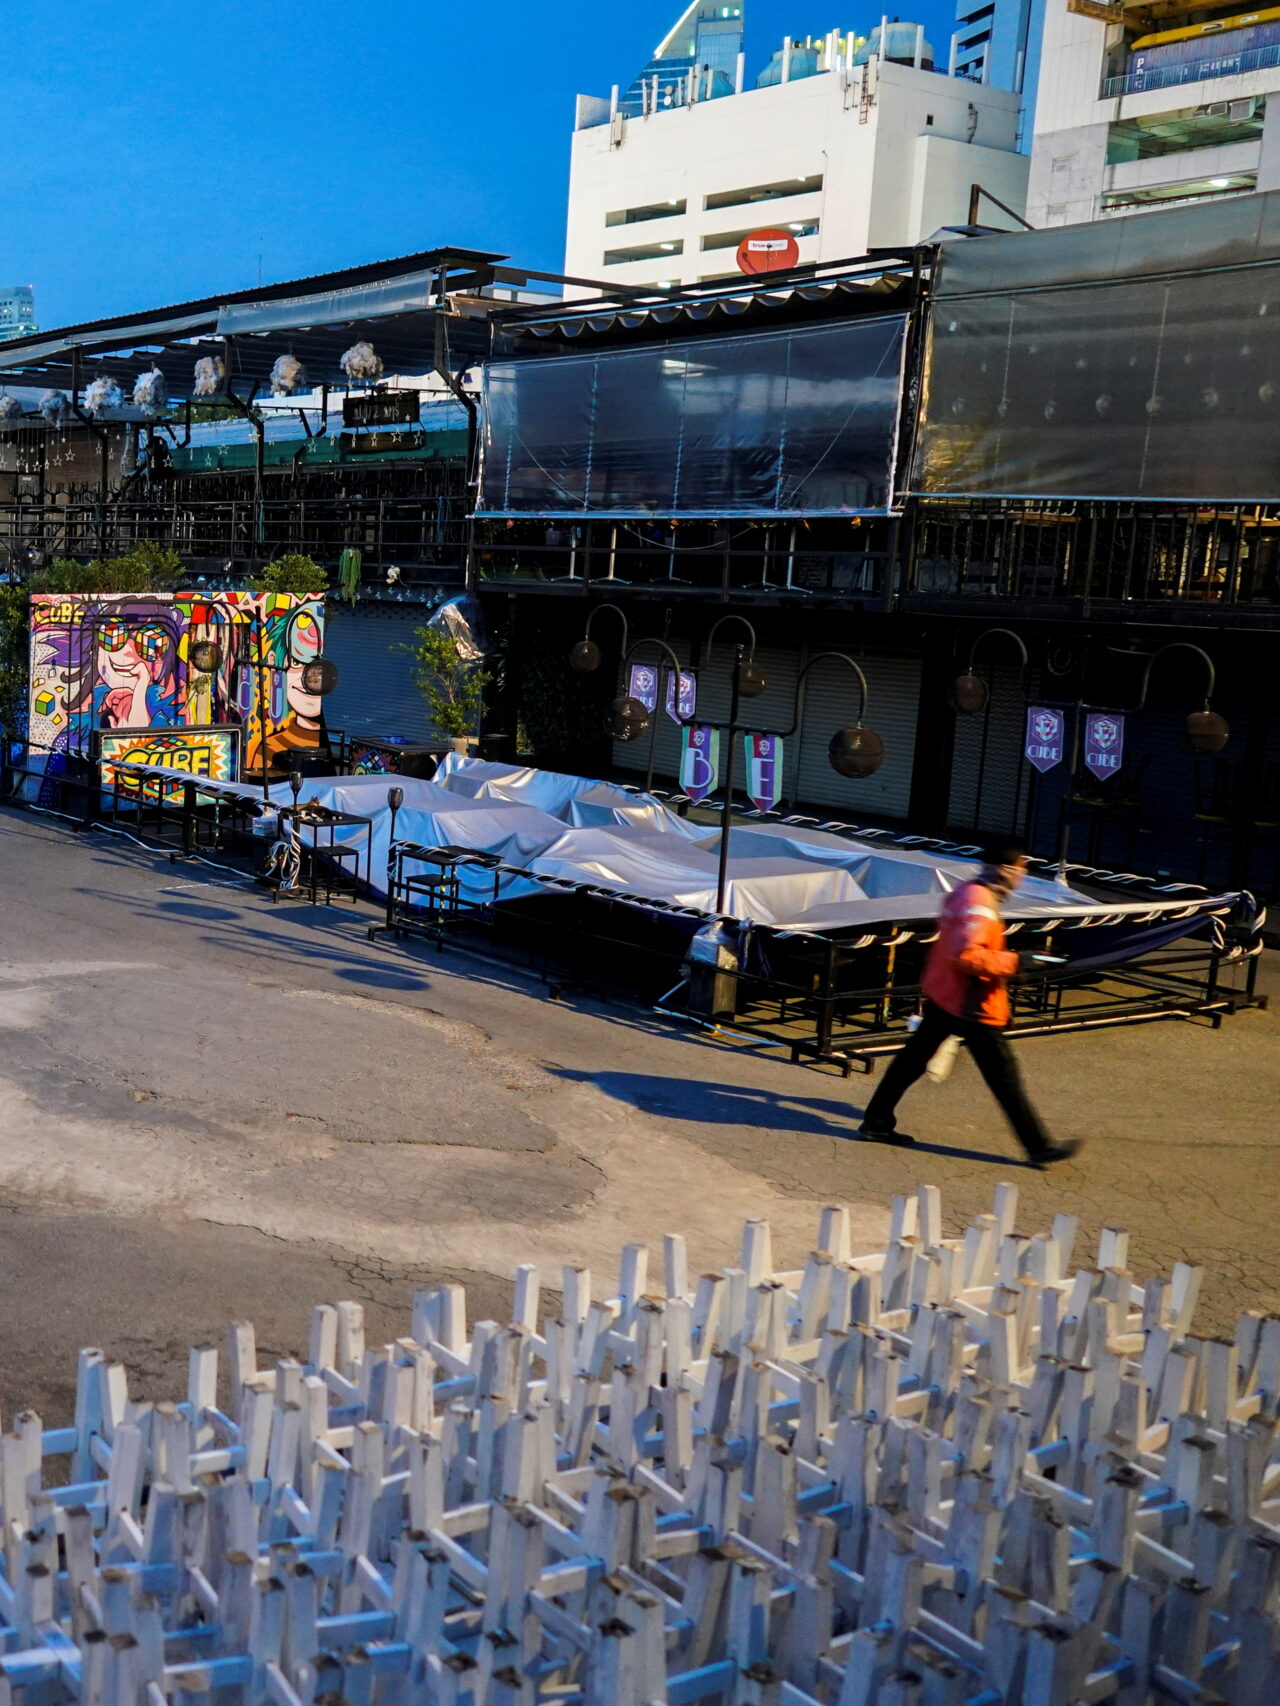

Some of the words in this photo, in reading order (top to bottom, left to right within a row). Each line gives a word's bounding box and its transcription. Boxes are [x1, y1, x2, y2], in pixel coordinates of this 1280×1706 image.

[34, 601, 85, 625] CUBE
[667, 701, 693, 714] CBE
[1027, 744, 1060, 761] CUBE
[1087, 752, 1118, 767] CUBE
[120, 746, 211, 787] CUBE
[683, 747, 714, 788] B
[751, 757, 775, 800] E
